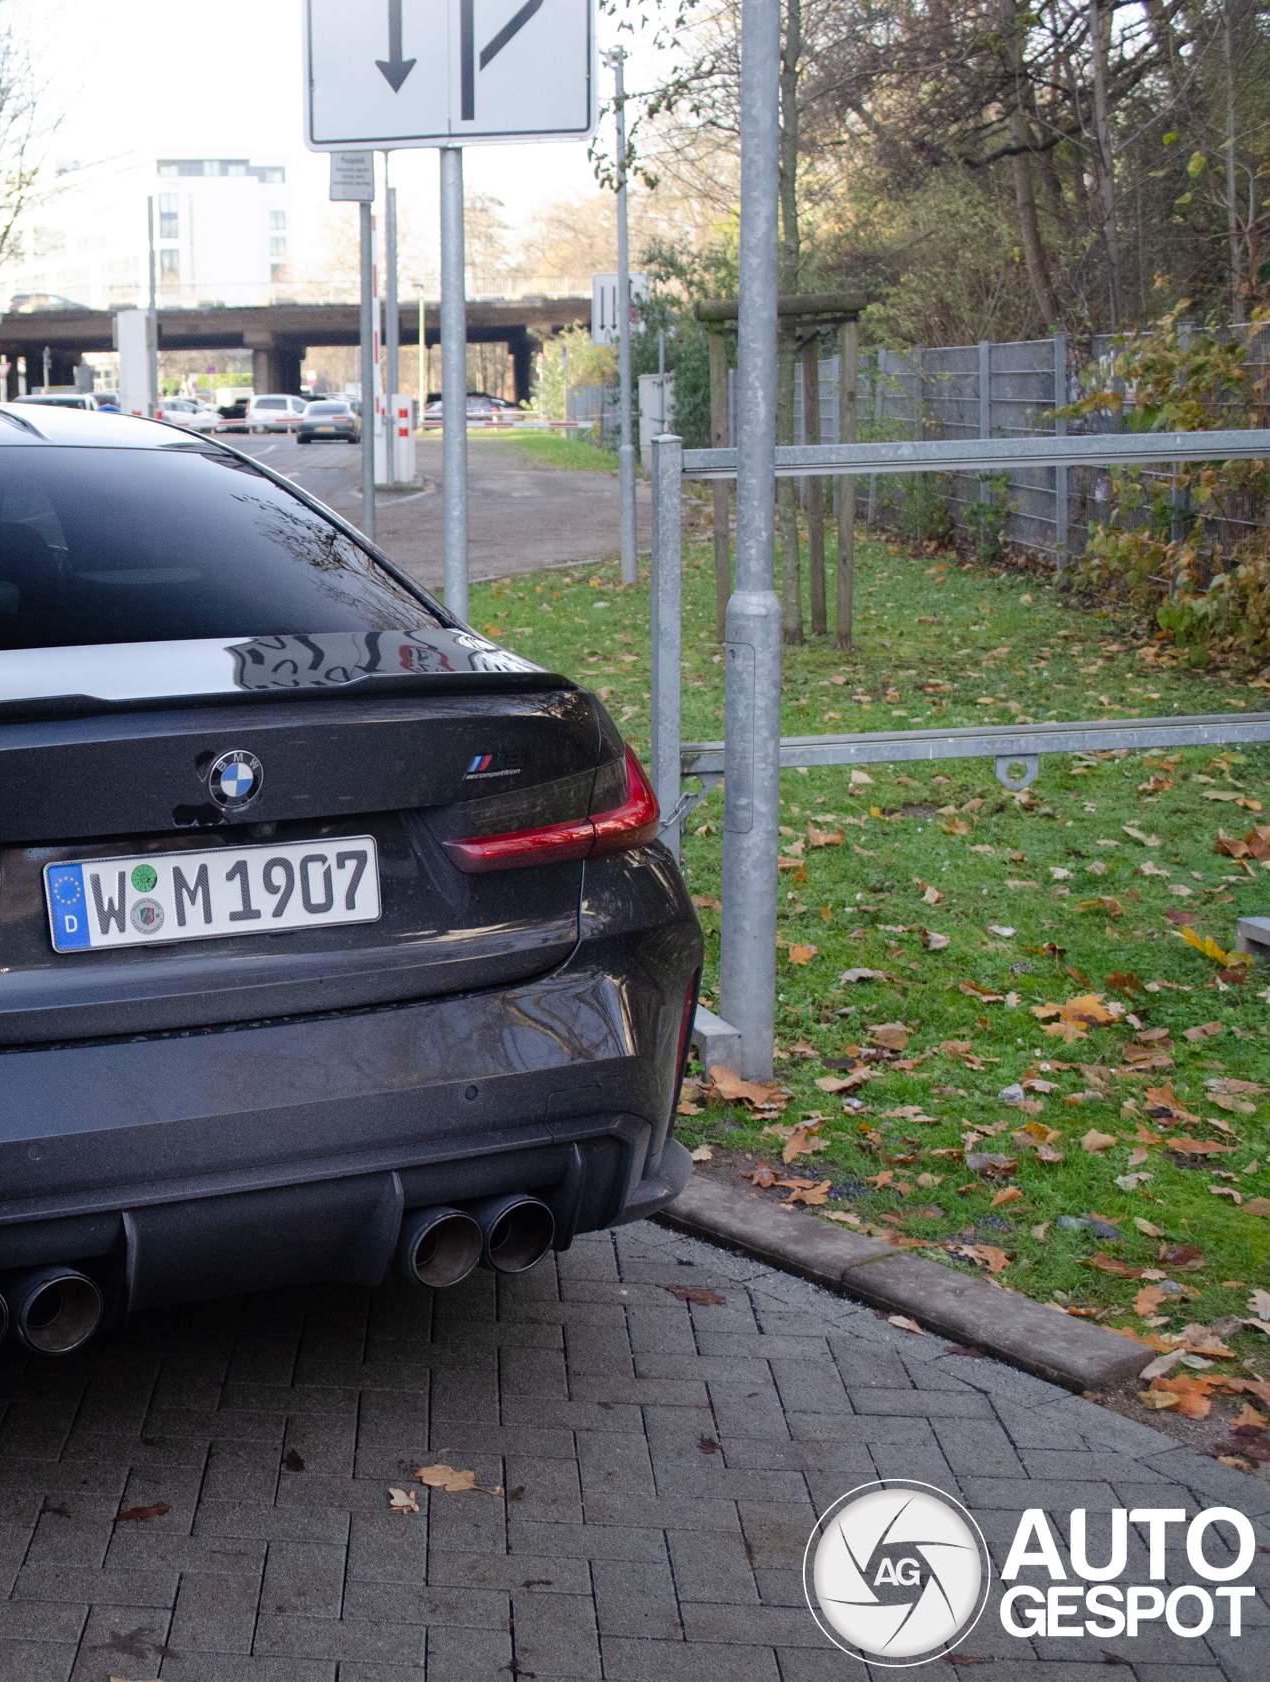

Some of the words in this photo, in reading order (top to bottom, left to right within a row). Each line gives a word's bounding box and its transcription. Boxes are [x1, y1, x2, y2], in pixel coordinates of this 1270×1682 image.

[216, 752, 260, 772] BMW
[474, 768, 521, 779] competition
[89, 870, 126, 935] W
[65, 914, 78, 933] D
